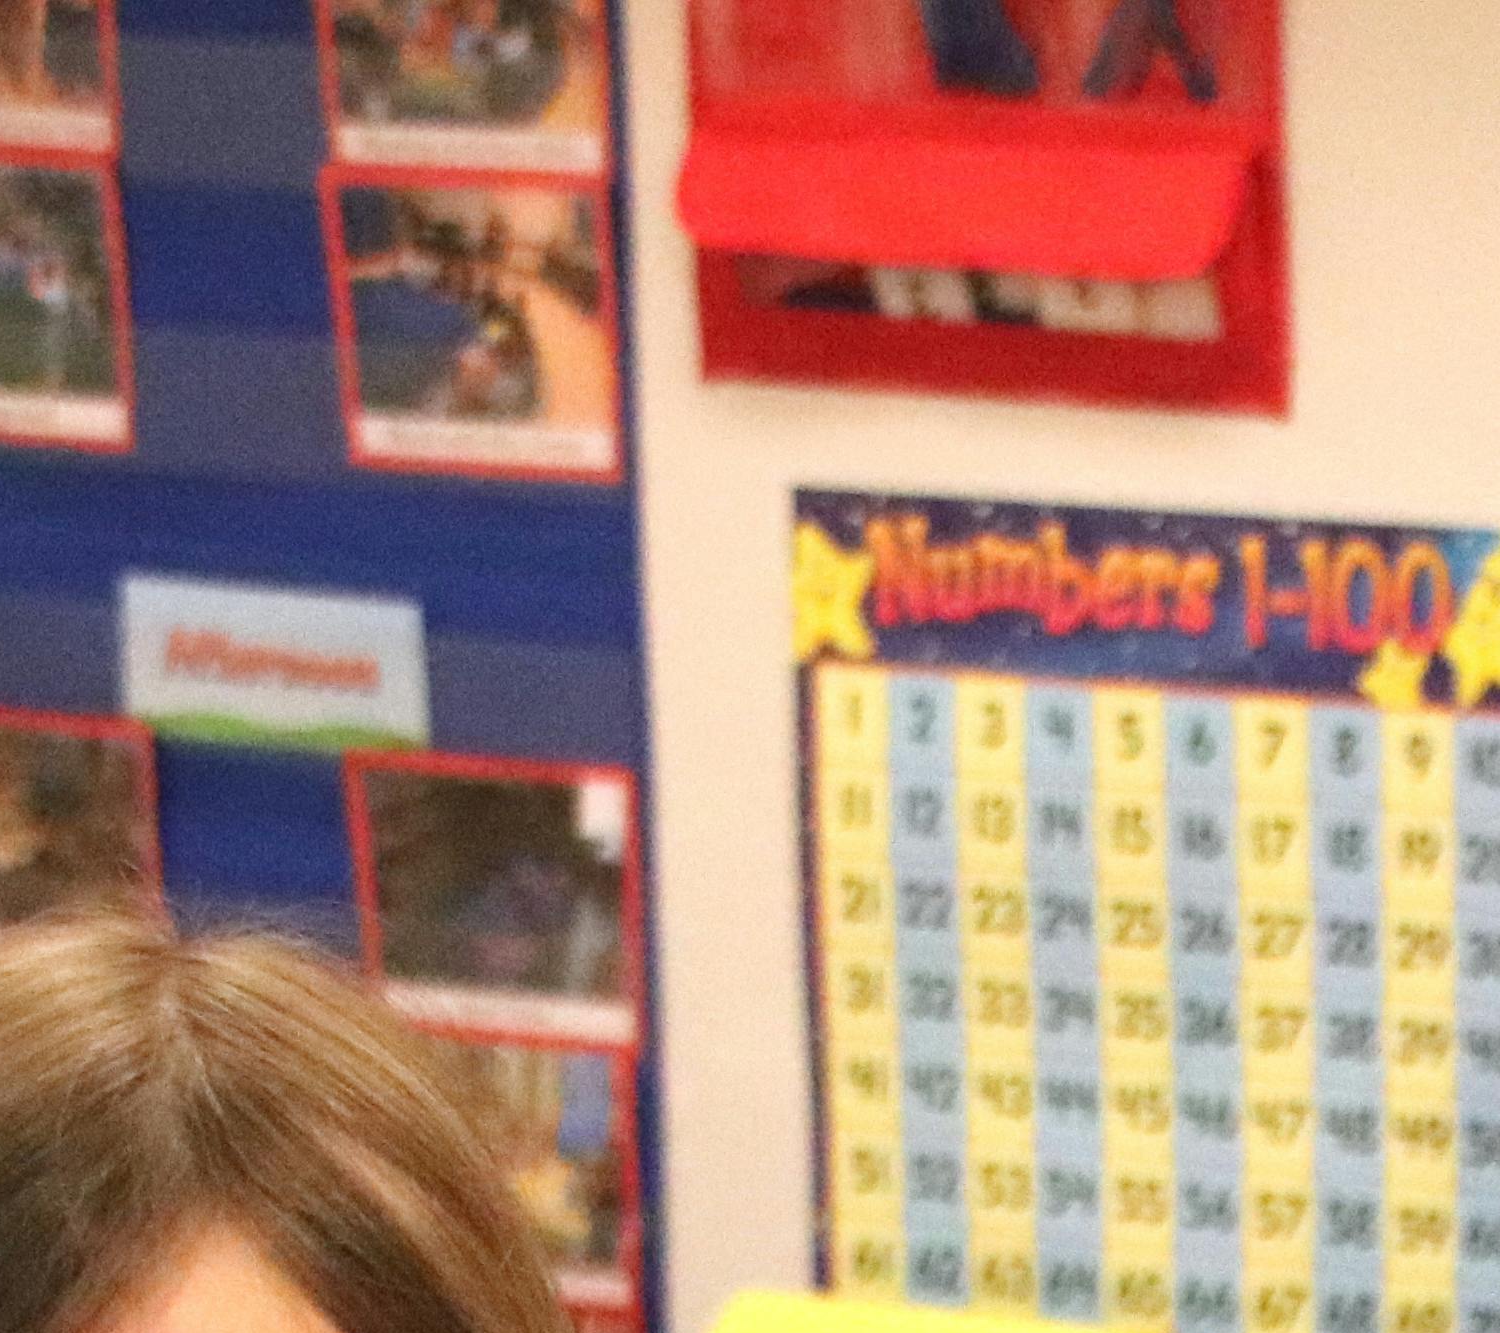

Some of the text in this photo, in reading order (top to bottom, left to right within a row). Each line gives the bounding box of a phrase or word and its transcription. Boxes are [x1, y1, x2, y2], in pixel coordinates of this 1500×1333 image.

[864, 513, 1455, 655] Numbers 1-100
[908, 691, 936, 746] 2
[980, 700, 1006, 749] 3
[1044, 706, 1075, 749] 4
[1117, 711, 1144, 759] 5
[1185, 720, 1215, 765] 6
[1260, 720, 1287, 766] 7
[1332, 725, 1359, 776] 8
[1404, 732, 1433, 774] 9
[840, 784, 874, 827] 11
[902, 787, 943, 839] 12
[971, 795, 1015, 844] 13
[1039, 801, 1082, 842] 14
[1111, 806, 1152, 854] 15
[1180, 815, 1223, 860] 16
[1250, 816, 1296, 862] 17
[1327, 822, 1367, 871] 18
[1399, 829, 1441, 869] 19
[840, 874, 881, 922] 21
[900, 879, 952, 930] 22
[971, 885, 1029, 935] 23
[1038, 891, 1091, 940] 24
[1109, 899, 1166, 947] 25
[1180, 905, 1231, 953] 26
[1250, 910, 1308, 959] 27
[1325, 916, 1374, 966] 28
[1395, 923, 1451, 970] 29
